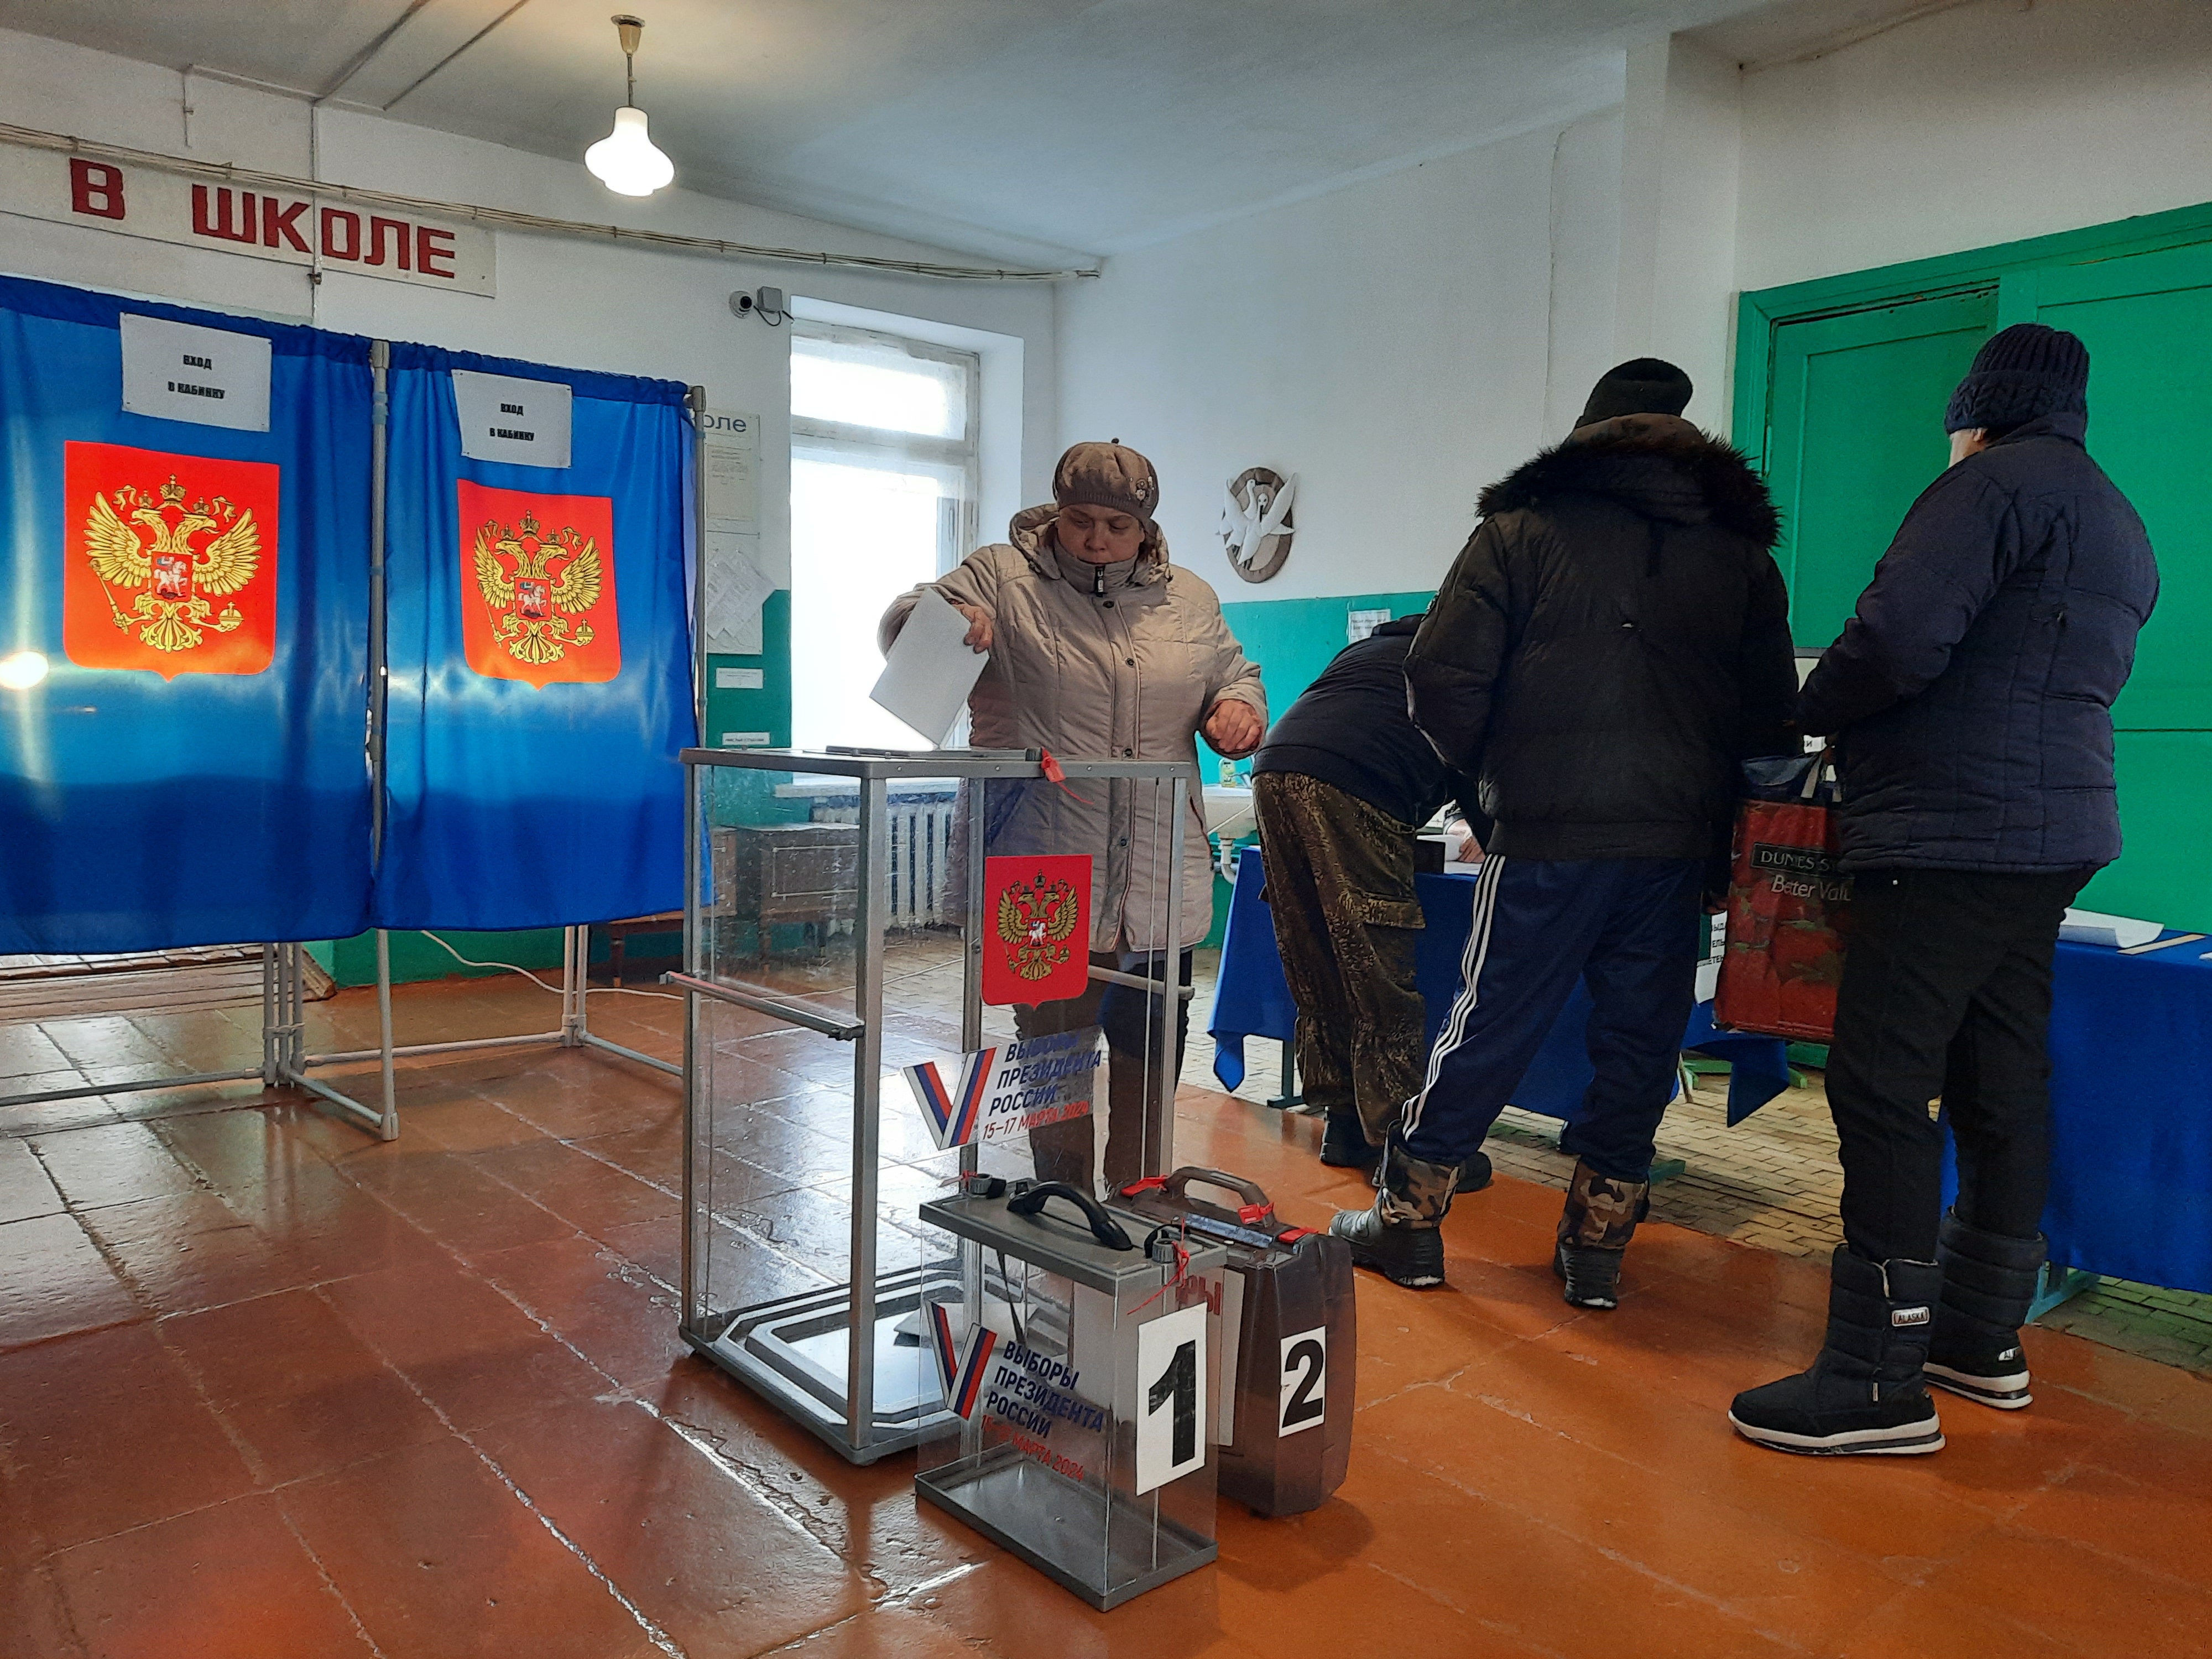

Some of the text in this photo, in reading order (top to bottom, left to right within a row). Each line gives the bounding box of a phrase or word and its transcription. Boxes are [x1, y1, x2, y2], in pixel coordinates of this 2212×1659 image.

[70, 157, 456, 279] В ШКОЛЕ
[183, 354, 212, 371] ВХОД
[489, 427, 495, 437] В
[500, 403, 524, 417] ВХОД
[1760, 851, 1816, 869] DUNES
[988, 1084, 1058, 1117] РОССИИ
[1003, 1340, 1079, 1390] ВЫБОРЫ
[1281, 1338, 1324, 1428] 2
[986, 1390, 1052, 1439] РОССИИ
[994, 1365, 1104, 1433] ПРЕЗИДЕНТА
[1149, 1339, 1196, 1468] 1
